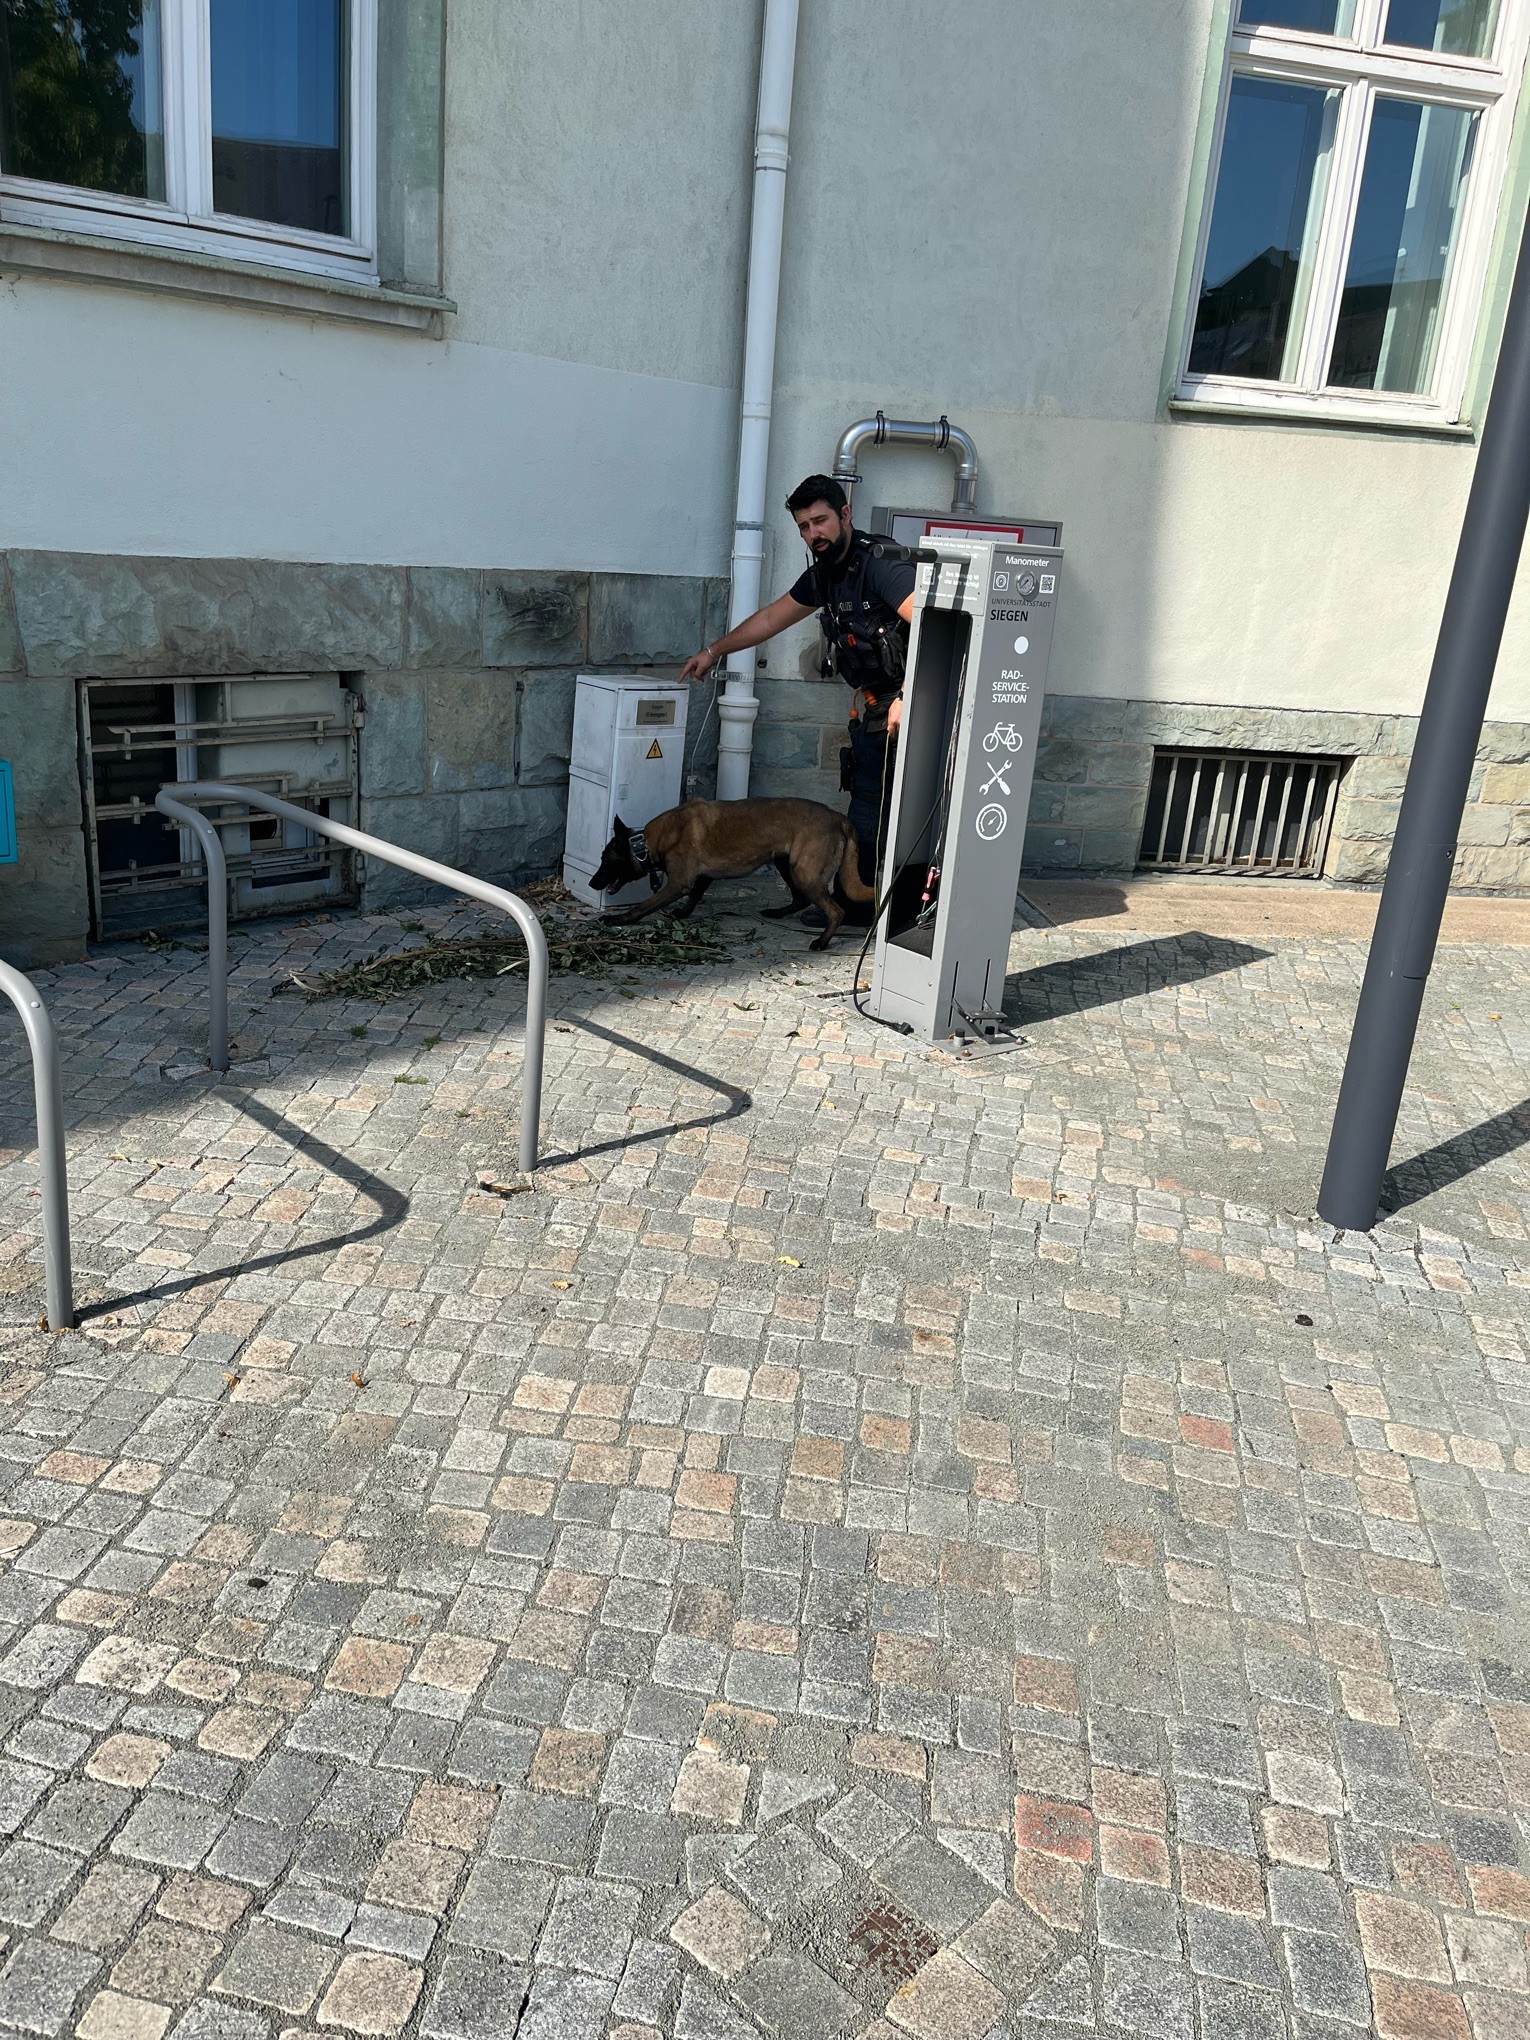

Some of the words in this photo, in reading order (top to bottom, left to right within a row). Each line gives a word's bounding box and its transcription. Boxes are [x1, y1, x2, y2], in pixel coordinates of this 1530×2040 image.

[1005, 556, 1049, 567] Manometer
[990, 609, 1029, 622] SIEGEN
[1001, 669, 1024, 680] RAD-
[991, 681, 1030, 692] SERVICE-
[991, 693, 1027, 704] STATION
